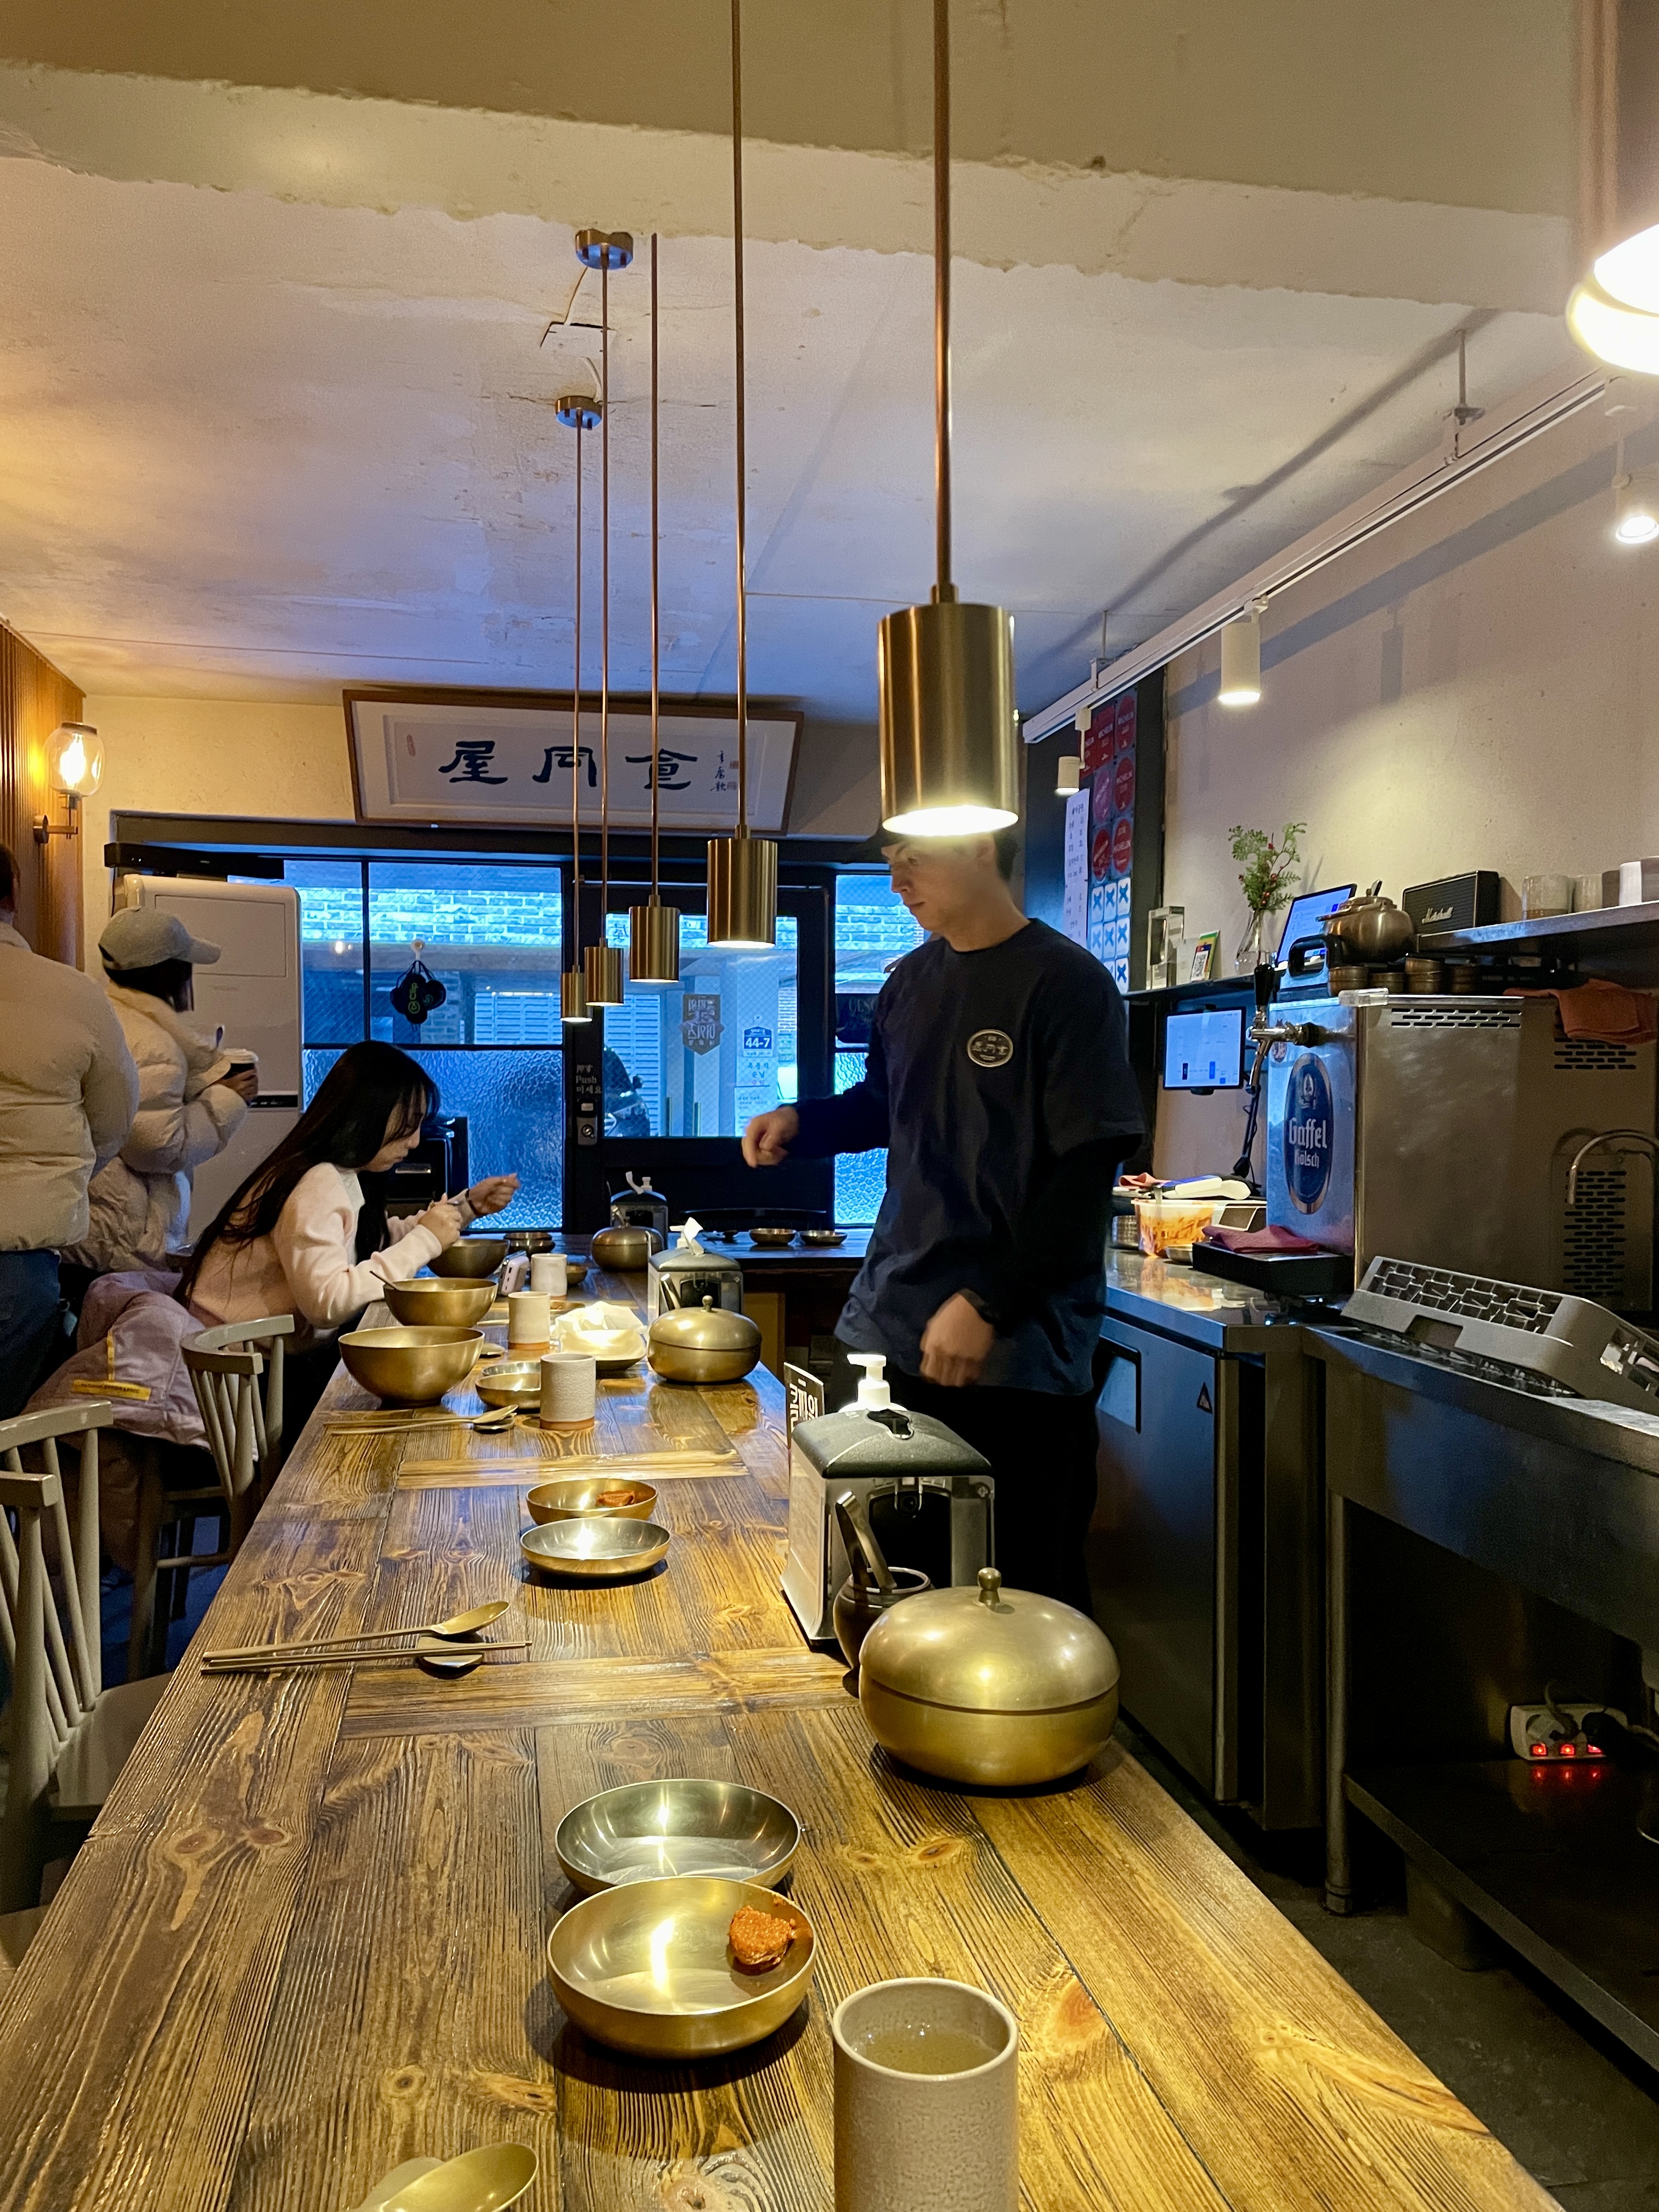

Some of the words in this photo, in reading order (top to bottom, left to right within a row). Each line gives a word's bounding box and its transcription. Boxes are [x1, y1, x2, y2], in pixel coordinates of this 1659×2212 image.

[1421, 906, 1453, 924] Marshall
[745, 1037, 770, 1048] 44-7
[576, 1075, 597, 1084] Push
[576, 1085, 602, 1094] 미세요
[1289, 1118, 1328, 1149] Gaffel
[1294, 1149, 1319, 1169] Kölsch
